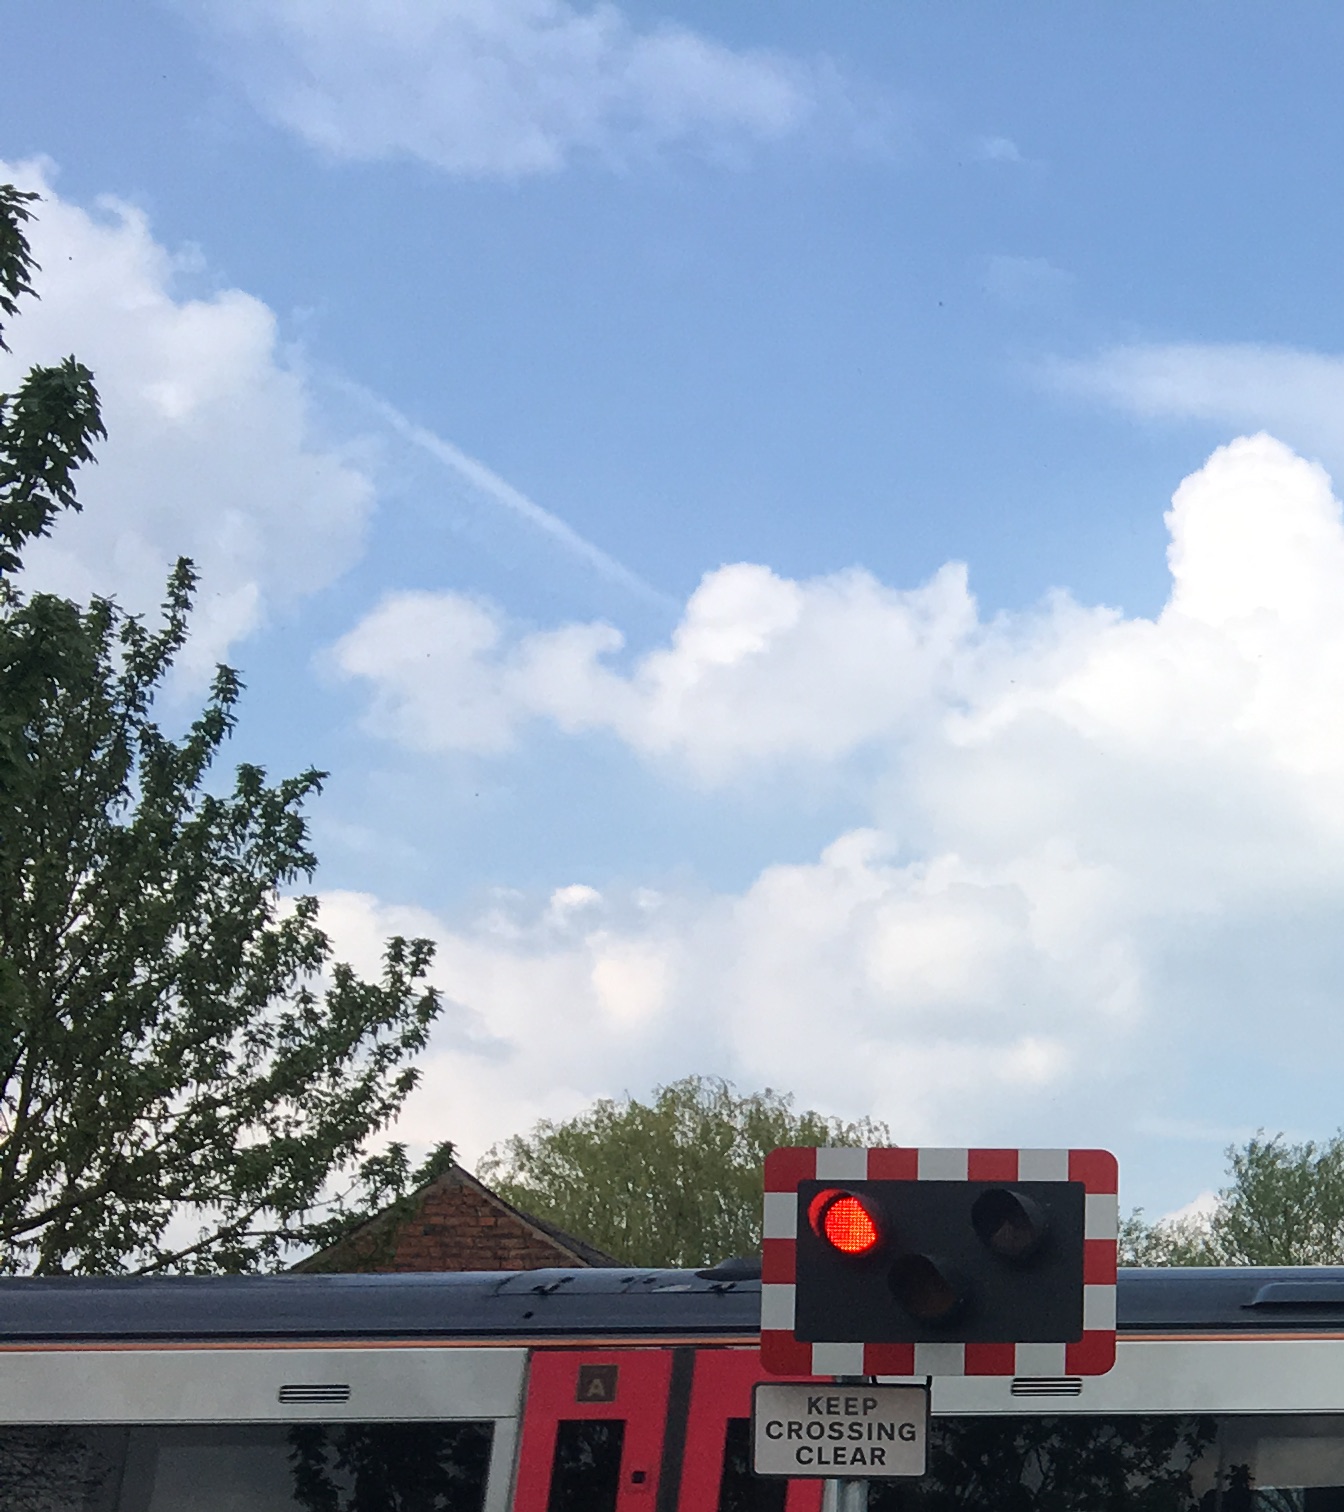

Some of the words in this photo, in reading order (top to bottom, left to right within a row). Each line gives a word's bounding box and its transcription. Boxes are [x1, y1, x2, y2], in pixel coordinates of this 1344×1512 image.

[587, 1378, 605, 1397] A
[807, 1396, 878, 1415] KEEP
[765, 1420, 916, 1441] CROSSING
[795, 1446, 886, 1466] CLEAR
